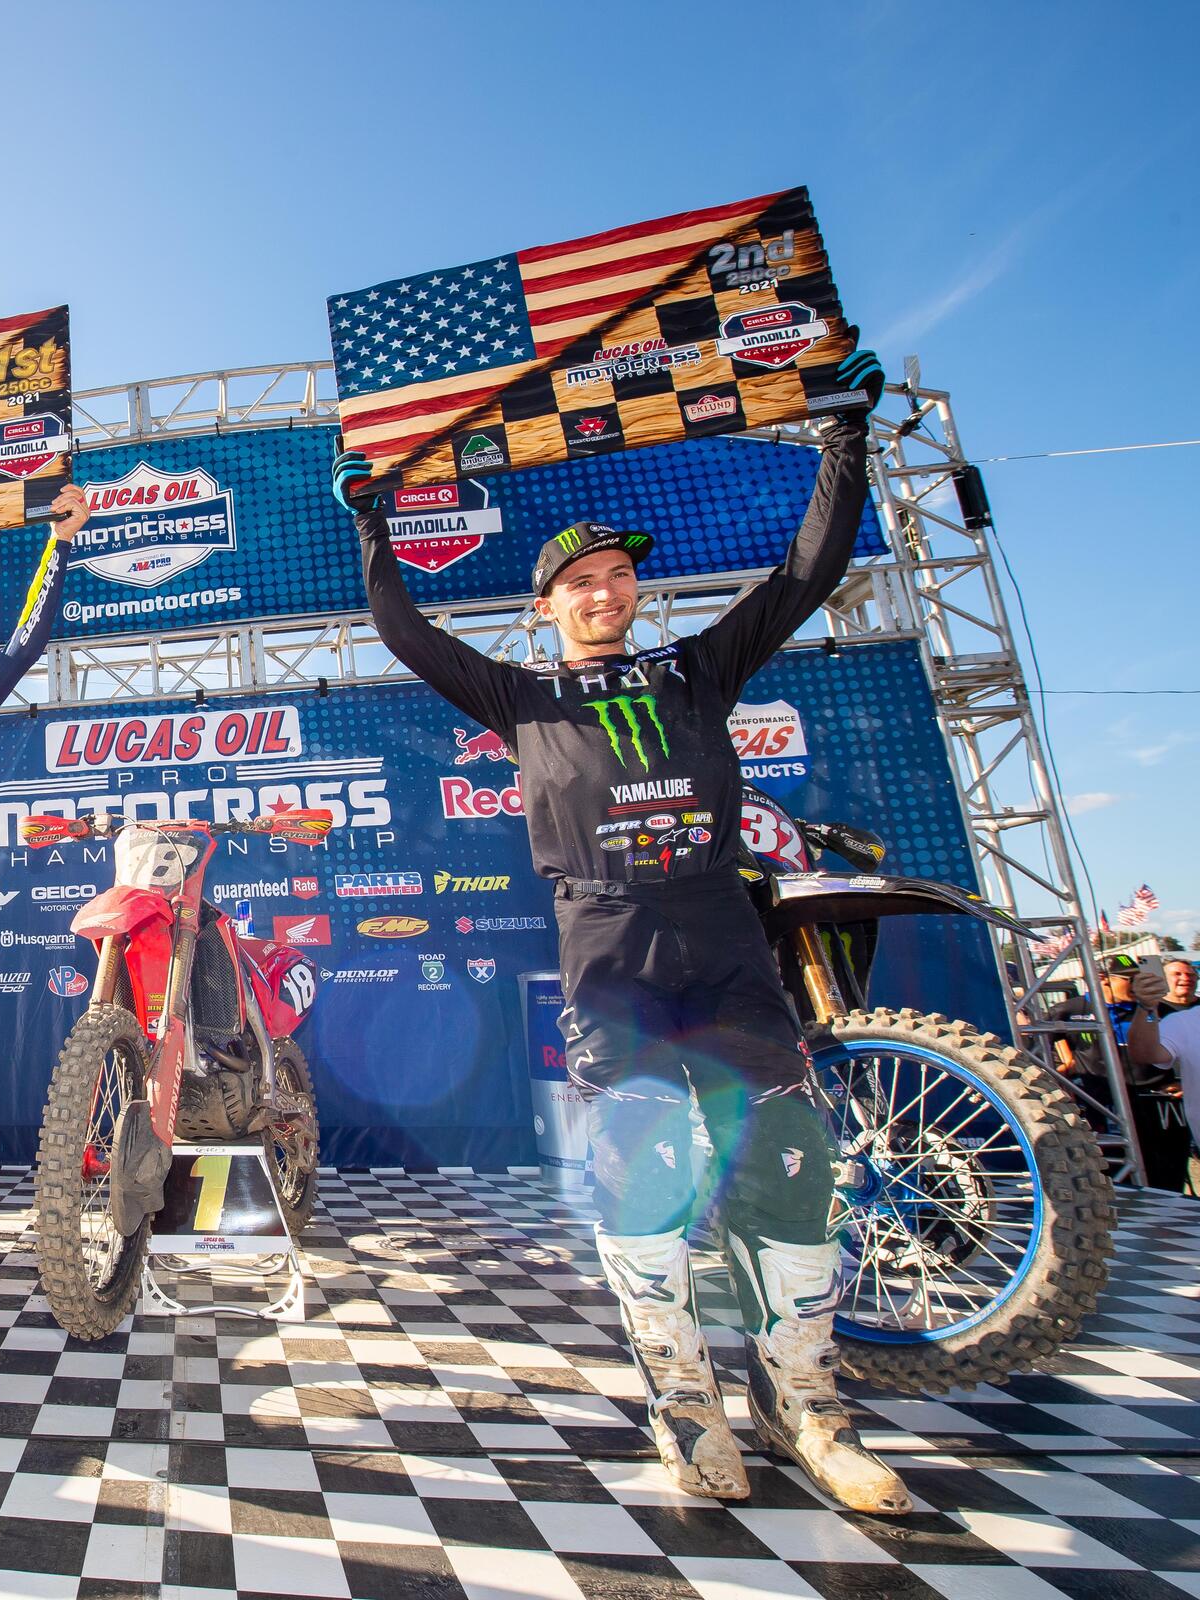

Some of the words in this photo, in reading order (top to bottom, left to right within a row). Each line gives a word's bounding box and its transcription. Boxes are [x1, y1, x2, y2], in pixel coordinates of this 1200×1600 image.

[708, 229, 794, 275] 2nd
[726, 264, 790, 287] 250cc
[739, 278, 779, 295] 2021
[746, 315, 775, 326] CIRCLE
[741, 328, 801, 347] UNADILLA
[594, 344, 642, 362] LUCAS
[642, 338, 667, 353] OIL
[743, 342, 805, 357] NATIONAL
[567, 349, 701, 384] MOTOCROSS
[8, 392, 40, 407] 2021
[808, 396, 829, 405] GRAIN
[690, 401, 731, 415] EKLUND
[7, 426, 30, 435] CIRCLE
[0, 440, 48, 456] UNADILLA
[0, 454, 49, 466] NATIONAL
[461, 453, 503, 466] Anderson
[89, 484, 159, 511] LUCAS
[164, 480, 200, 501] OIL
[400, 491, 436, 503] CIRCLE
[441, 490, 450, 500] K
[125, 513, 166, 522] PRO
[71, 514, 225, 547] MOTOCROSS
[391, 516, 468, 537] UNADILLA
[70, 529, 227, 554] CHAMPIONSHIP
[393, 538, 471, 551] NATIONAL
[127, 561, 155, 572] AMA
[63, 588, 241, 623] @promotocross
[730, 715, 796, 726] PERFORMANCE
[56, 718, 205, 768] LUCAS
[213, 710, 290, 753] OIL
[730, 726, 795, 757] CAS
[118, 766, 227, 788] PRO
[741, 763, 806, 779] DUCTS
[610, 778, 693, 804] YAMALUBE
[748, 793, 774, 808] LUCAS
[595, 819, 642, 835] GYTR
[650, 817, 672, 826] BELL
[29, 834, 61, 844] CYCRA
[281, 830, 319, 840] CYCRA
[689, 827, 704, 842] VP
[740, 805, 803, 871] 32
[336, 872, 421, 888] PARTS
[451, 876, 511, 891] THOR
[31, 884, 97, 900] GEICO
[214, 878, 288, 903] guaranteed
[293, 880, 317, 892] Rate
[337, 885, 422, 897] UNLIMITED
[357, 918, 429, 934] FMF
[475, 916, 546, 931] SUZUKI
[15, 933, 75, 946] Husqvarna
[334, 969, 399, 979] DUNLOP
[429, 968, 438, 979] 2
[476, 966, 488, 978] X
[49, 966, 76, 996] VP
[418, 983, 451, 991] RECOVERY
[283, 963, 315, 1016] 18
[168, 1050, 183, 1135] DUNLOP
[190, 1155, 232, 1231] 1
